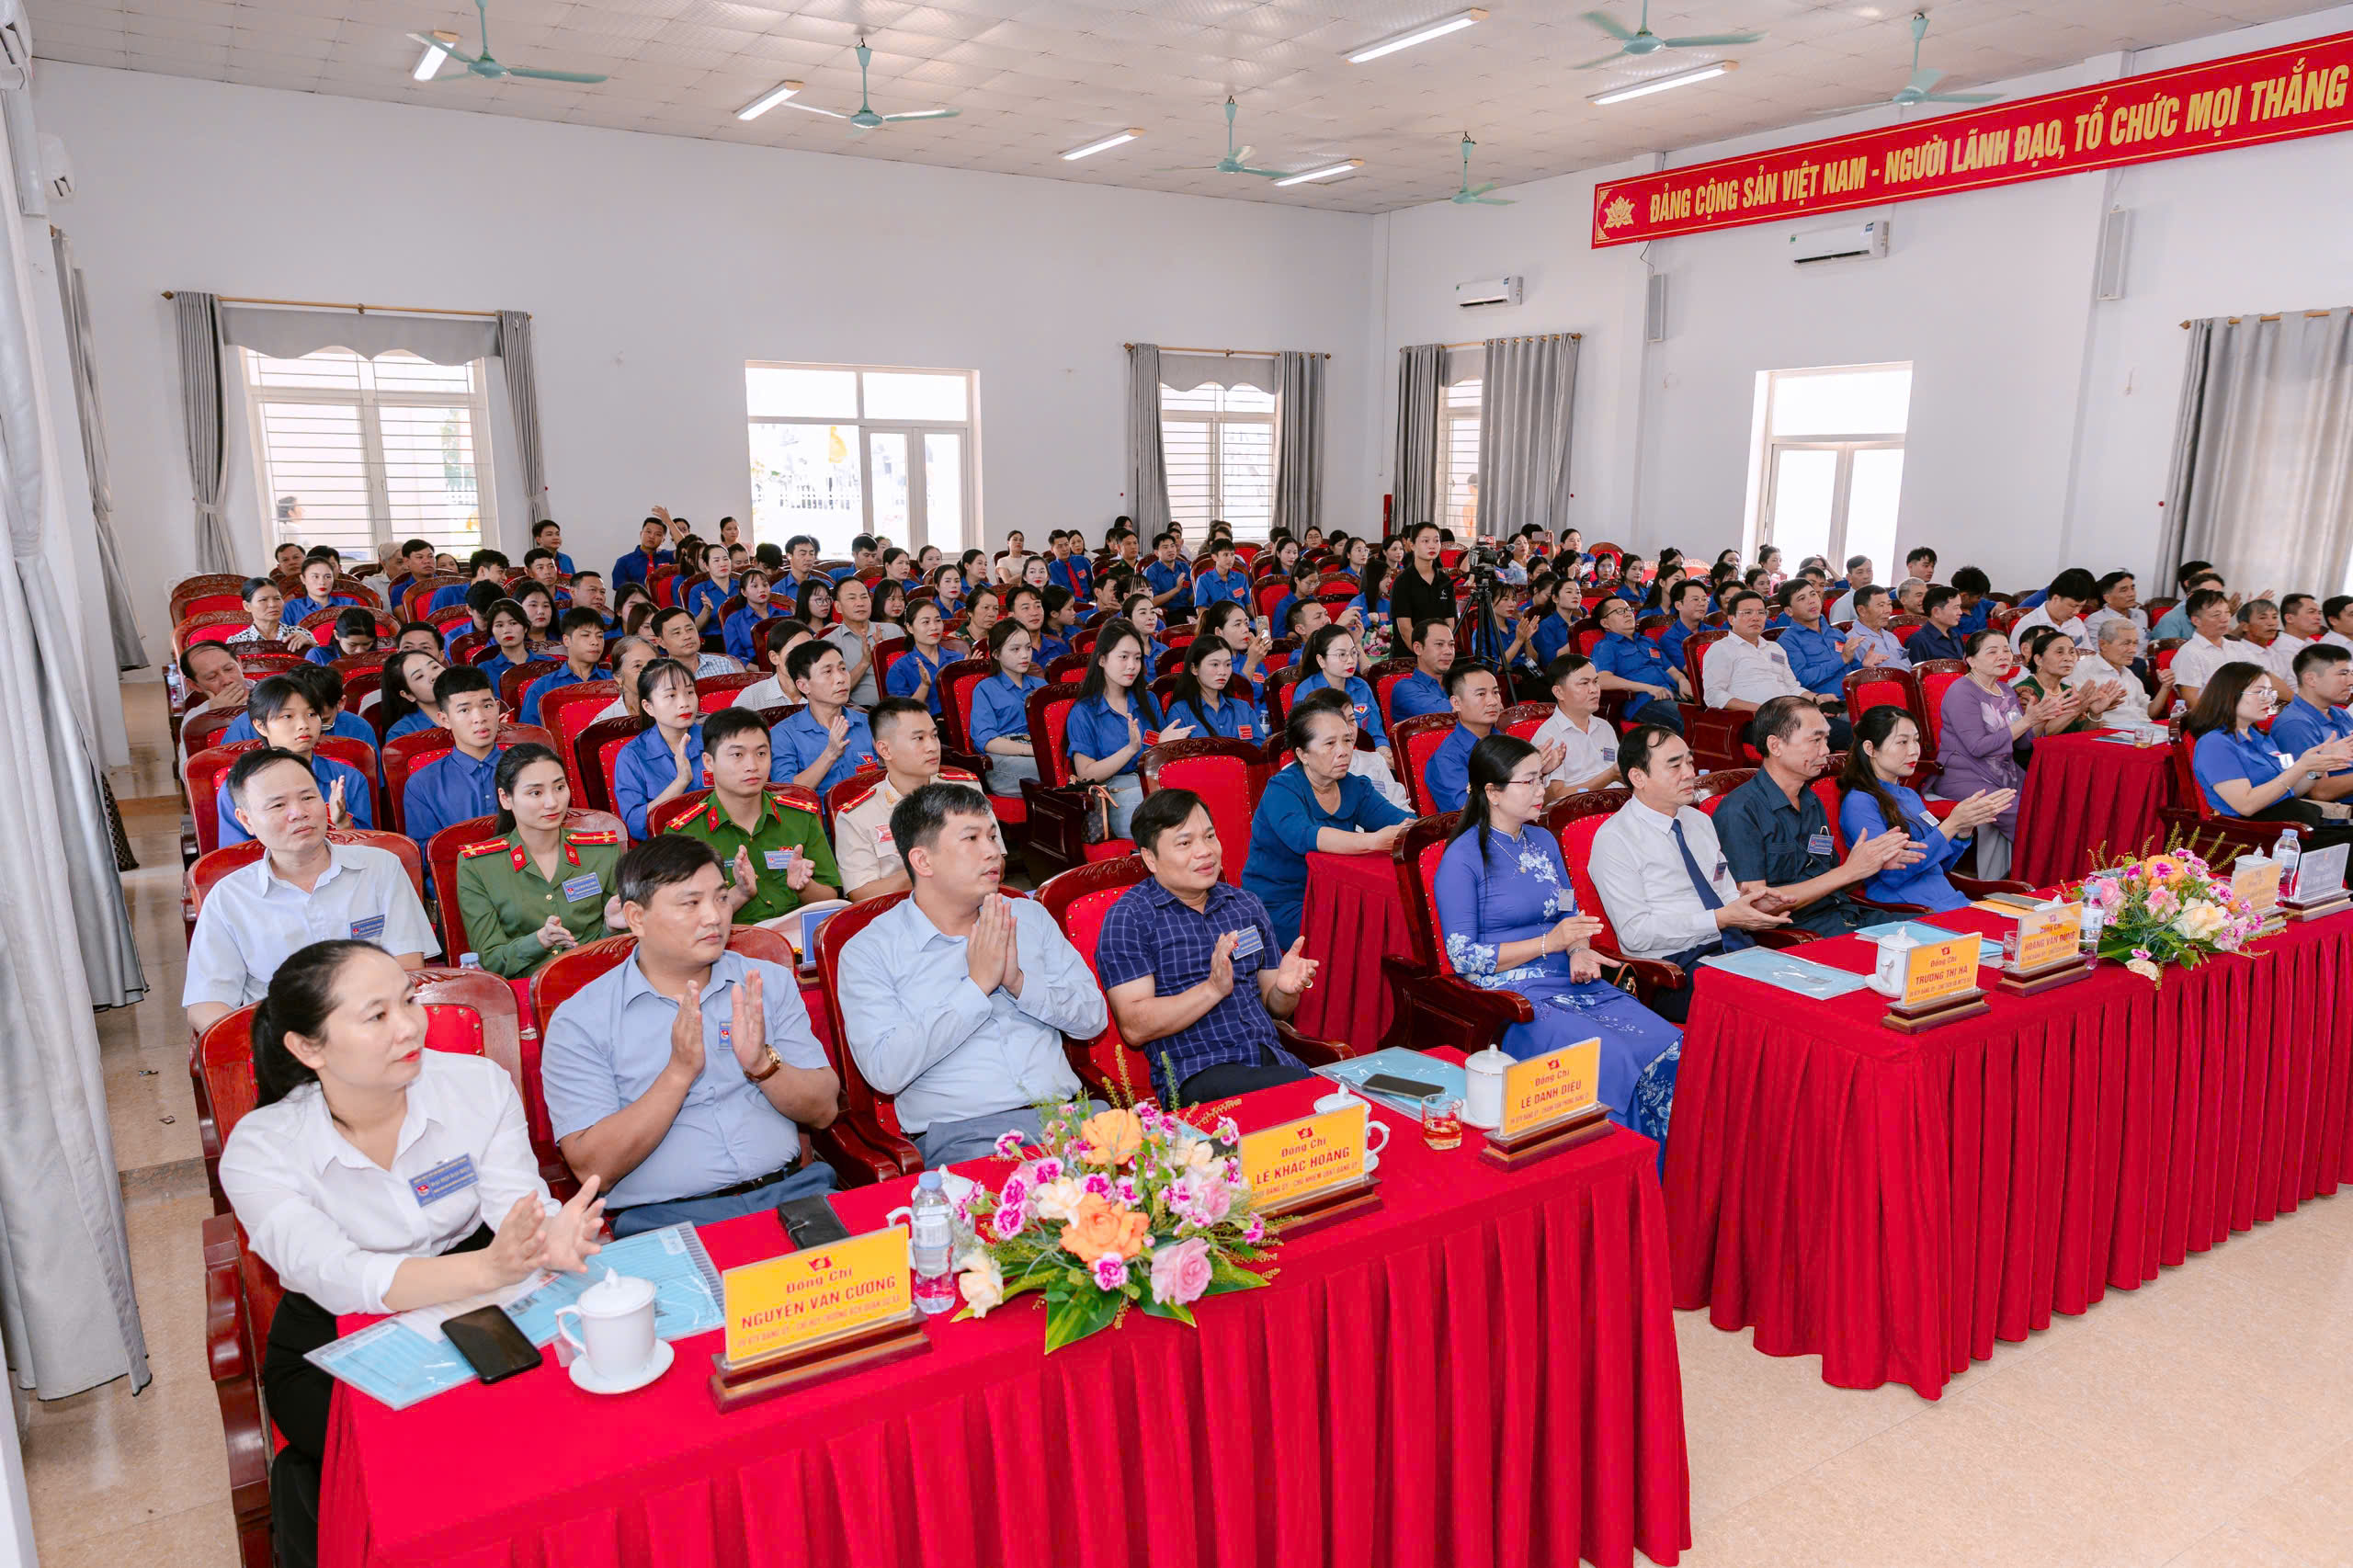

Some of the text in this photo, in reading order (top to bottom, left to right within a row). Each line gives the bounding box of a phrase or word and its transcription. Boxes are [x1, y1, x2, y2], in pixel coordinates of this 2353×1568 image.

[1650, 183, 1691, 223] ĐẢNG
[1695, 177, 1738, 221] CỘNG
[1743, 165, 1778, 208] SẢN
[1782, 161, 1820, 206] VIỆT
[1823, 156, 1867, 195] NAM
[1884, 134, 1948, 184] NGƯỜI
[1951, 128, 2010, 173] LÃNH
[2014, 119, 2065, 168] ĐẠO,
[2075, 96, 2108, 152] TỔ
[2109, 93, 2179, 146] CHỨC
[2185, 85, 2242, 138] MỌI
[2249, 57, 2349, 122] THẮNG
[1534, 1087, 1559, 1104] DANH
[1256, 1168, 1270, 1185] LÊ
